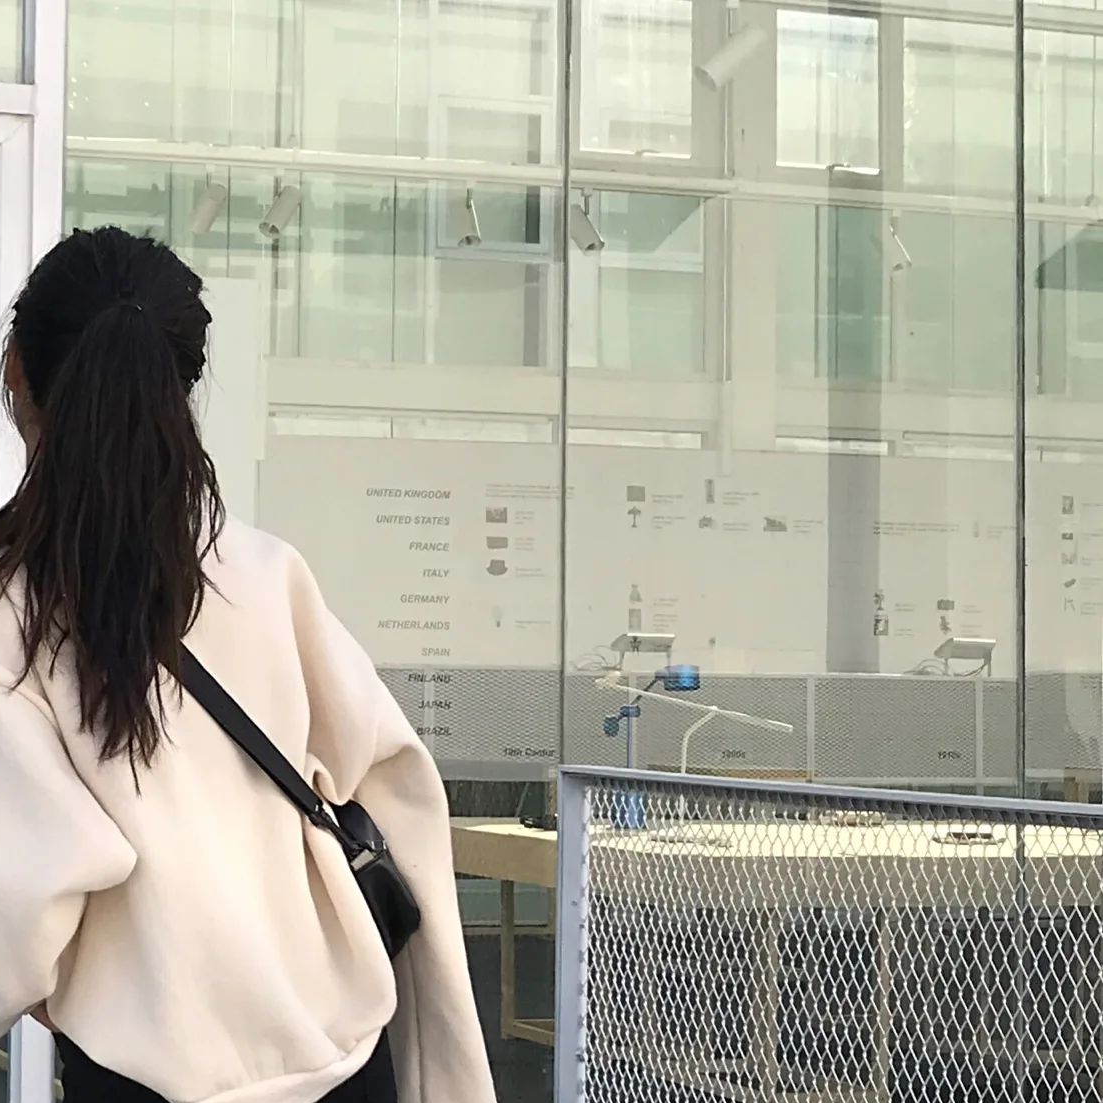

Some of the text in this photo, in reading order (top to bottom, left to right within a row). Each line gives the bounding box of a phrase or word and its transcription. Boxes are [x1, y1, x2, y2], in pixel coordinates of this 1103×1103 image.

[366, 487, 451, 500] UNITED KINGDOM
[376, 514, 450, 526] UNITED STATES
[408, 541, 450, 552] FRANCE
[422, 568, 450, 578] ITALY
[400, 594, 450, 604] GERMANY
[377, 620, 451, 631] NETHERLANDS
[421, 647, 451, 657] SPAIN
